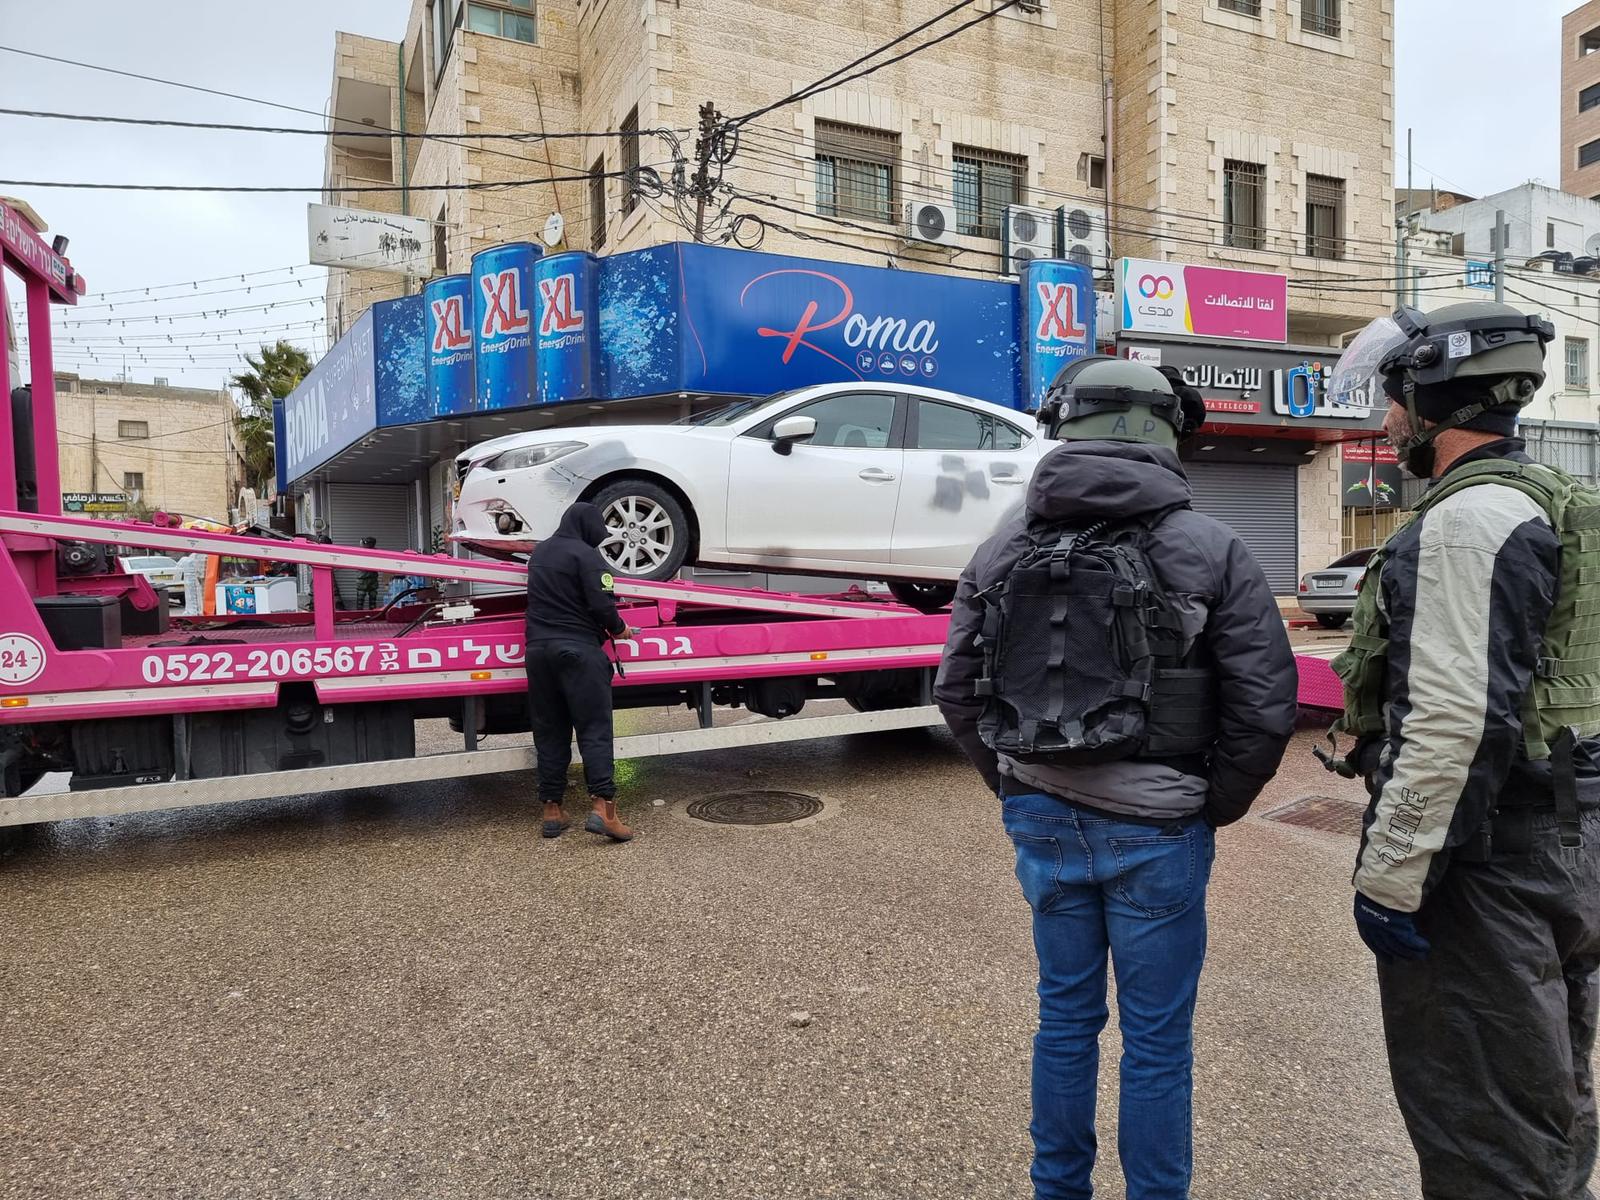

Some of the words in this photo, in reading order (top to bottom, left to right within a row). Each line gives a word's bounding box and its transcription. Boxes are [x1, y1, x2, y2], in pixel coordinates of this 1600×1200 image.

[360, 215, 383, 225] القدس
[481, 268, 530, 338] XL
[539, 274, 584, 335] XL
[1138, 305, 1174, 317] مدى
[1204, 294, 1254, 309] للاتصالات
[1257, 297, 1275, 311] لفتا
[1037, 282, 1087, 342] XL
[431, 296, 473, 352] XL
[740, 269, 939, 382] Roma
[480, 338, 511, 354] Energy
[509, 336, 531, 349] Drink
[538, 335, 567, 350] Energy
[565, 334, 586, 346] Drink
[1035, 343, 1067, 356] Energy
[1066, 345, 1087, 356] Drink
[325, 328, 371, 391] SUPERMARKET
[431, 352, 457, 366] Energy
[1182, 365, 1262, 398] للإتصالات
[1218, 402, 1254, 411] TELECOM
[286, 377, 328, 469] ROMA
[1112, 415, 1128, 434] A
[1142, 419, 1156, 433] P
[408, 639, 525, 669] שלים
[613, 636, 694, 657] גרר
[1, 649, 28, 668] 24
[142, 645, 374, 683] 0522-206567
